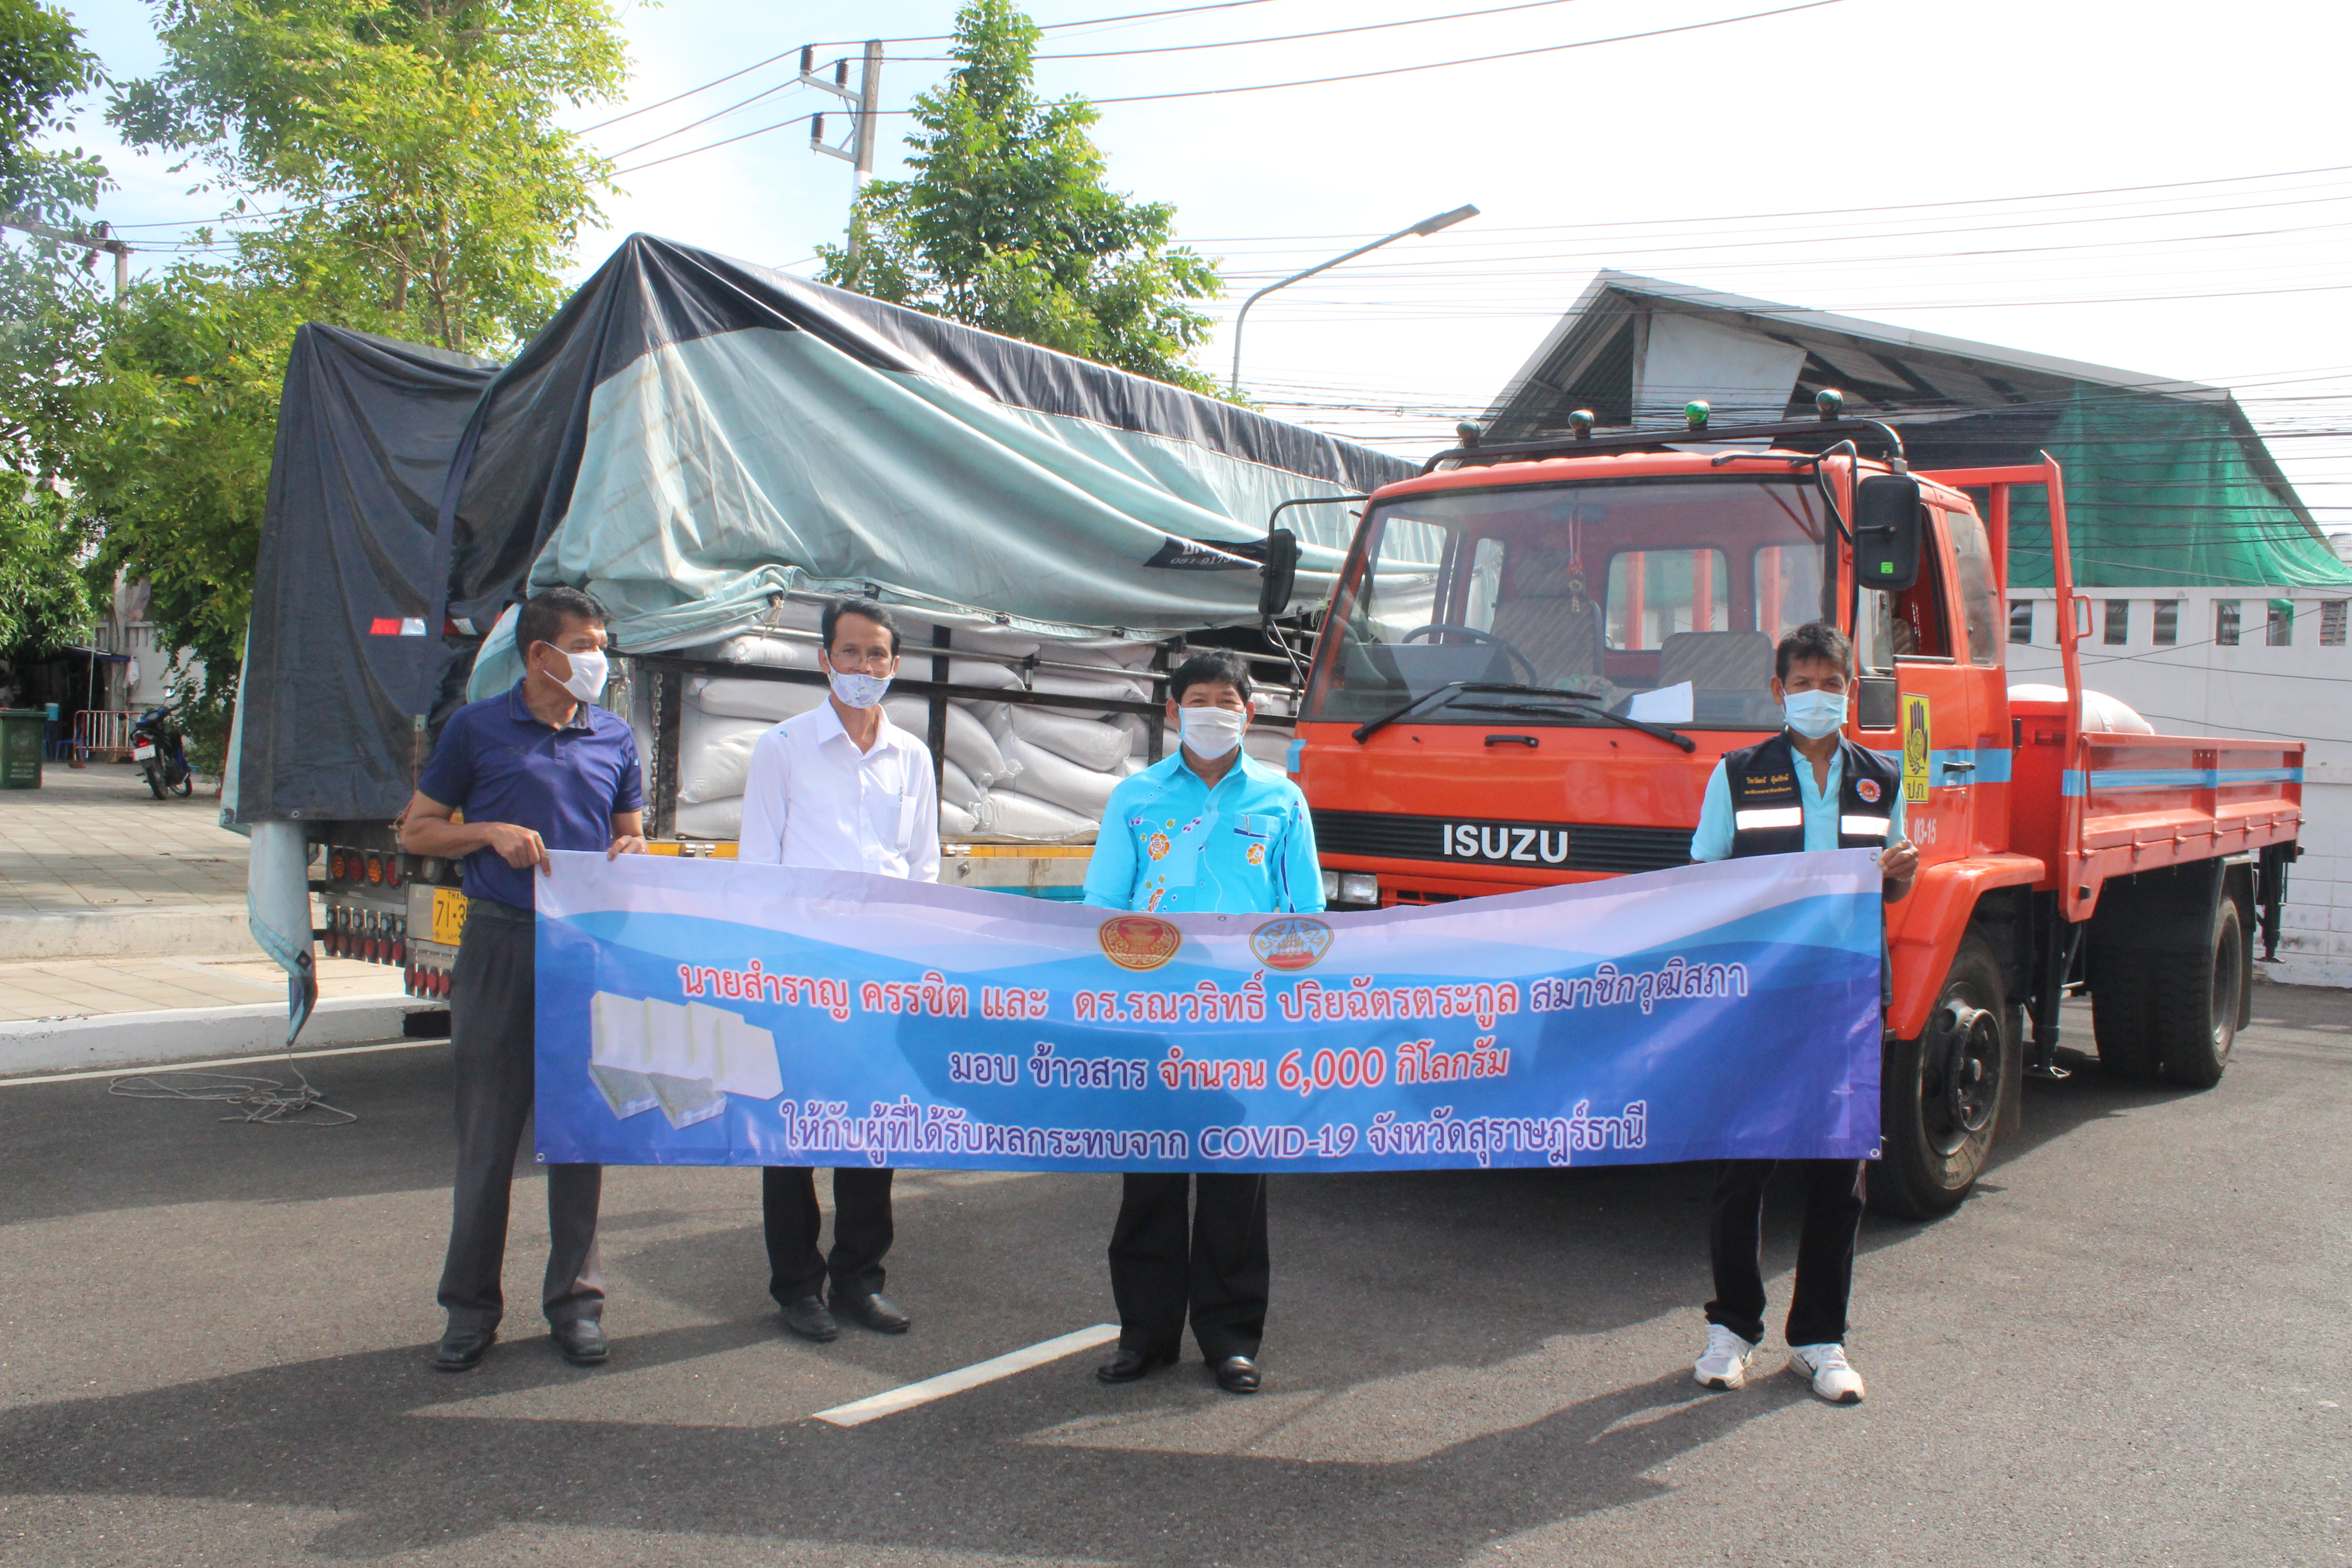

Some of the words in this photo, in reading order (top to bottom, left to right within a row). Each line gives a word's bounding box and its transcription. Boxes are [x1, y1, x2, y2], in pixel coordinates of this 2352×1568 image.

[1443, 824, 1568, 863] ISUZU
[1915, 818, 1937, 844] 03-15
[436, 901, 466, 927] 71-3
[681, 960, 848, 1020] นายสำราญ
[863, 971, 967, 1015] ครรชิต
[983, 988, 1048, 1018] และ
[1075, 969, 1265, 1020] ดร.รณวริทธิ์
[1279, 976, 1516, 1028] ปริยฉัตรตระกูล
[1532, 957, 1746, 1013] สมาชิกวุฒิสภา
[951, 1054, 1016, 1083] มอบ
[1030, 1043, 1147, 1088] ข้าวสาร
[1160, 1047, 1265, 1088] จำนวน
[1279, 1049, 1384, 1094] 6,000
[1397, 1037, 1509, 1083] กิโลกรัม
[781, 1098, 1186, 1165] ให้กับผู้ที่ได้รับผลกระทบจาก
[1199, 1126, 1357, 1158] COVID-19
[1368, 1102, 1646, 1165] จังหวัดสุราษฎร์ธานี
